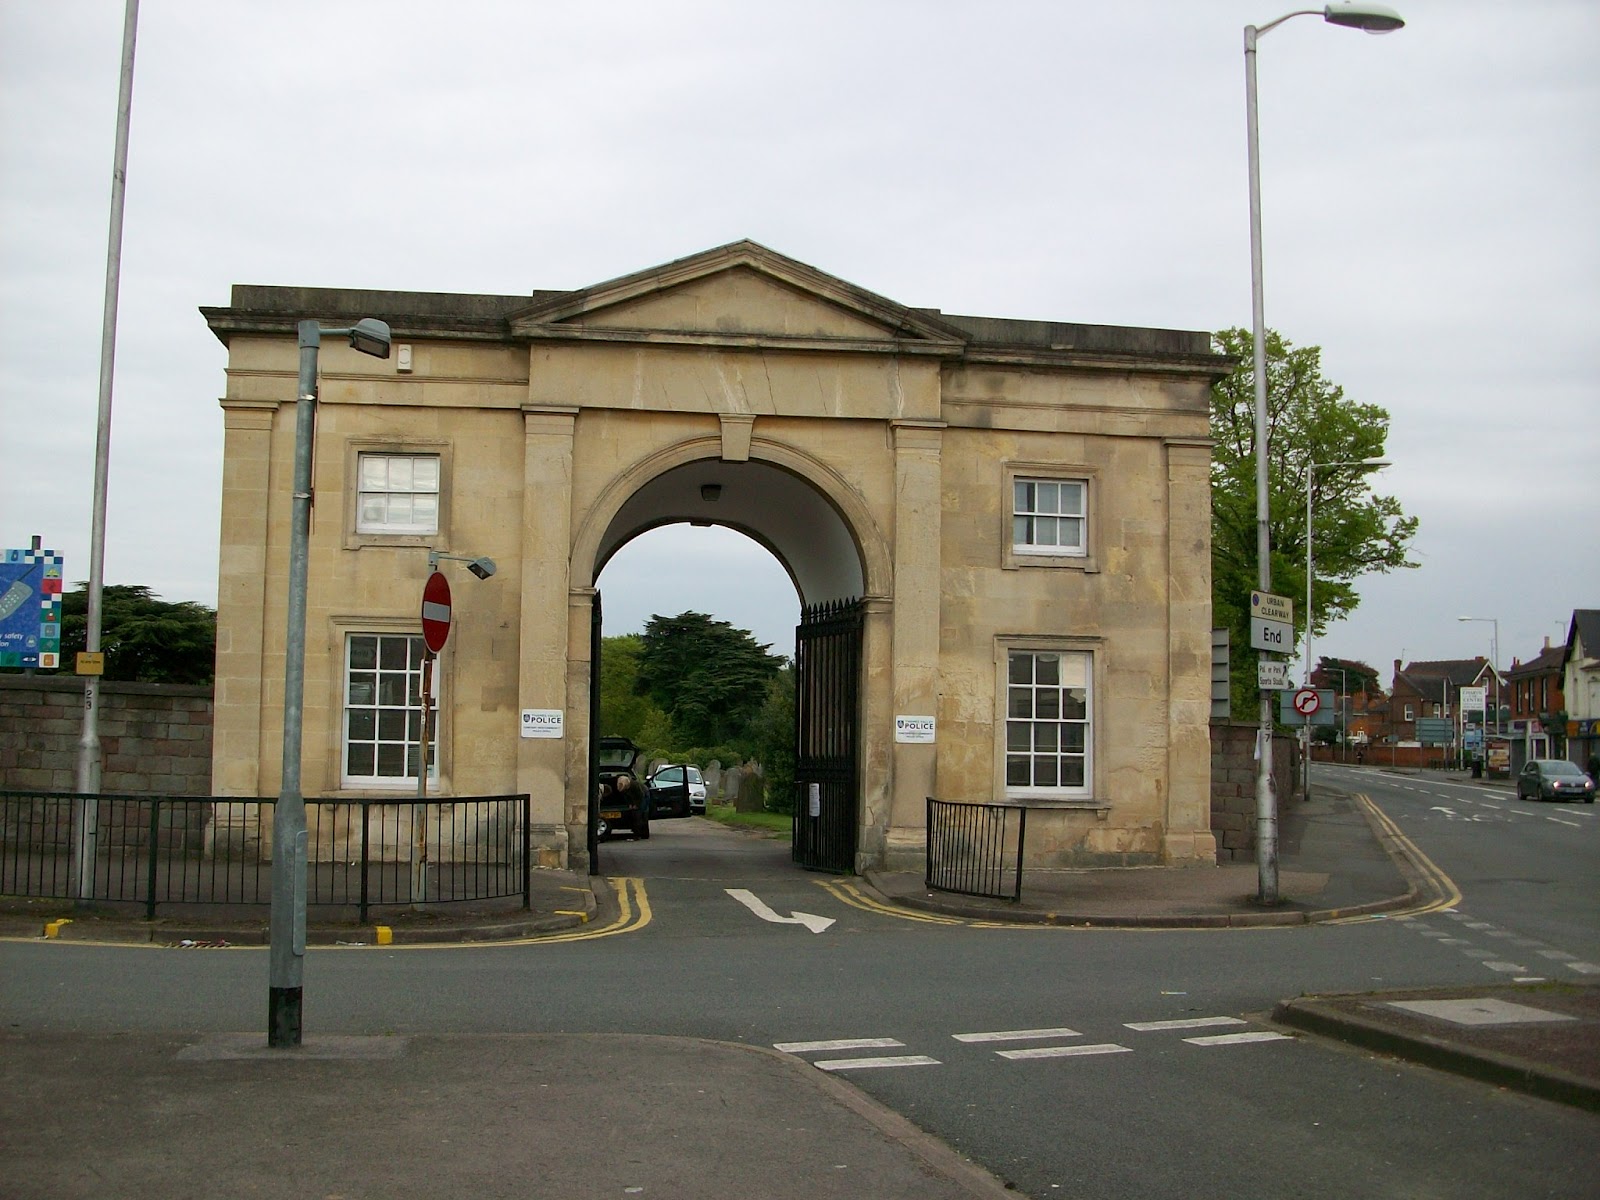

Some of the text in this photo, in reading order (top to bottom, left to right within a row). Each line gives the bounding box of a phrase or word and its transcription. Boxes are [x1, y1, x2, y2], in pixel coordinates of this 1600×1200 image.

[1266, 596, 1284, 607] URBAN
[1261, 607, 1289, 618] CLEARWAY
[4, 633, 24, 641] safety
[1263, 627, 1281, 643] End
[531, 716, 562, 724] POLICE
